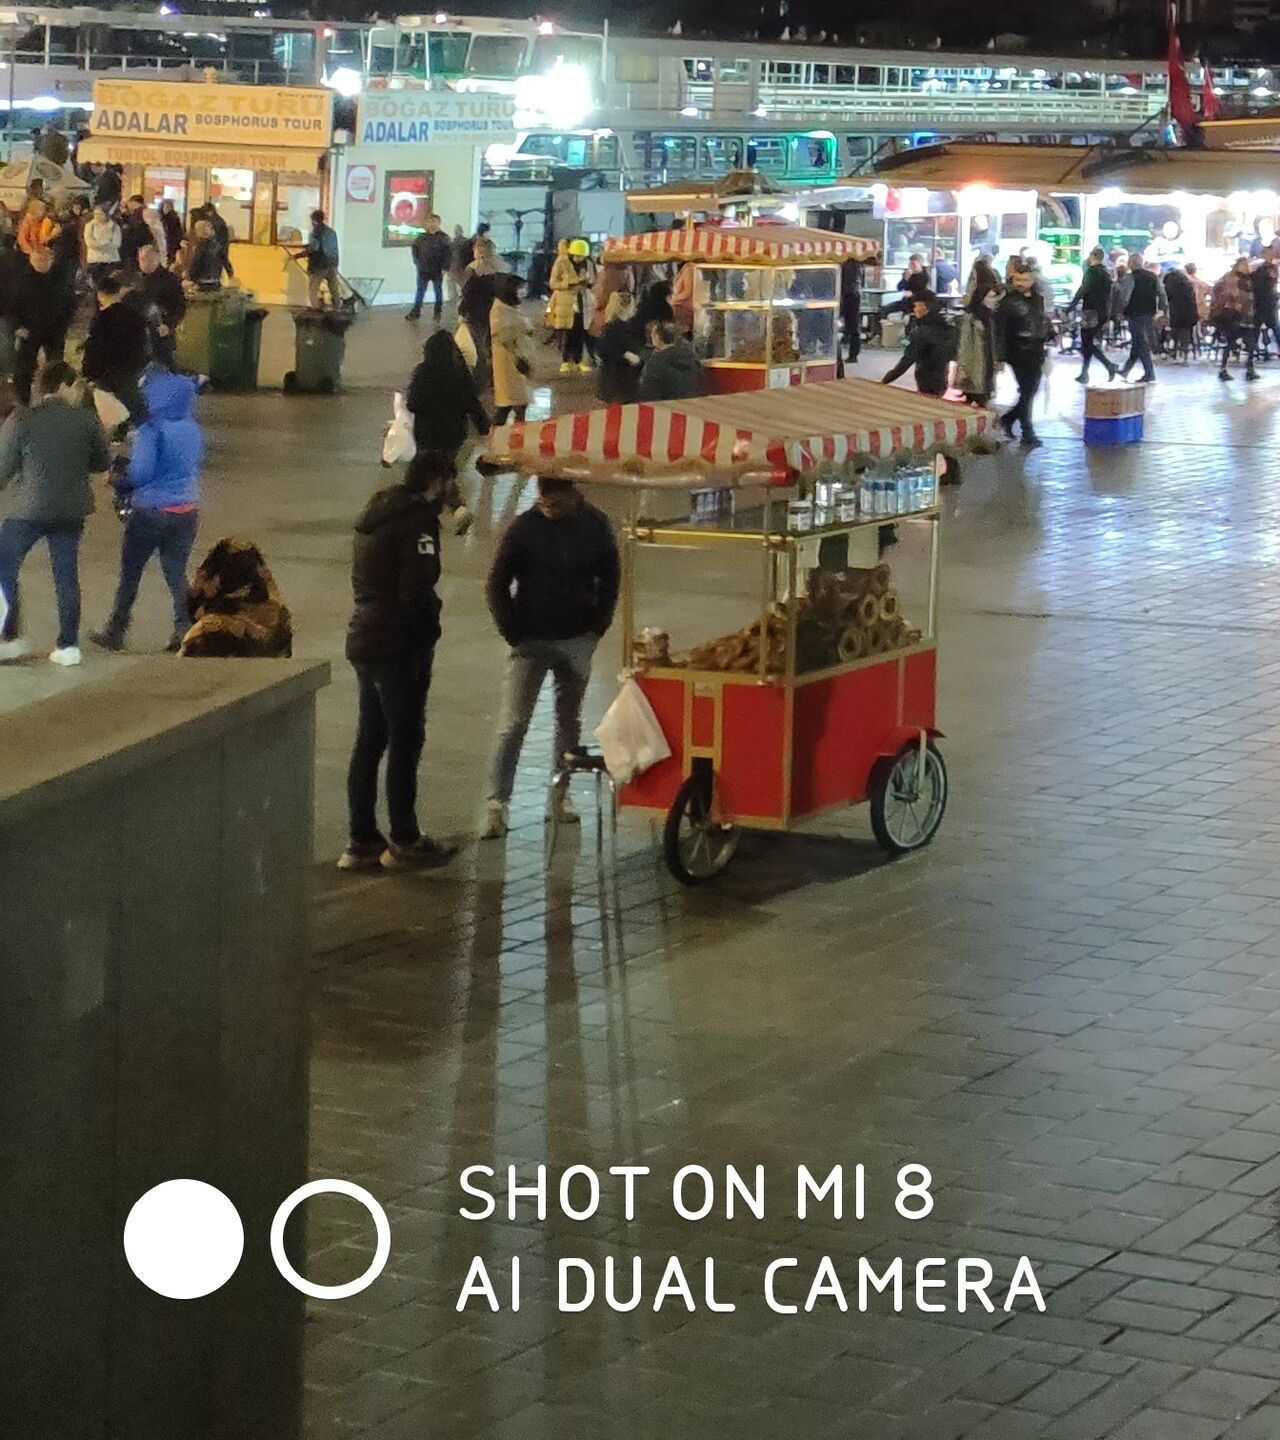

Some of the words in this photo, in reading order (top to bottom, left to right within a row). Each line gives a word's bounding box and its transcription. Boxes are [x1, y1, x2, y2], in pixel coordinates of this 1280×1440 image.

[96, 109, 188, 135] ADALAR
[195, 113, 278, 128] BOSPHORUS
[284, 118, 322, 130] TOUR
[363, 120, 430, 142] ADALAR
[433, 120, 489, 131] BOSPHORUS
